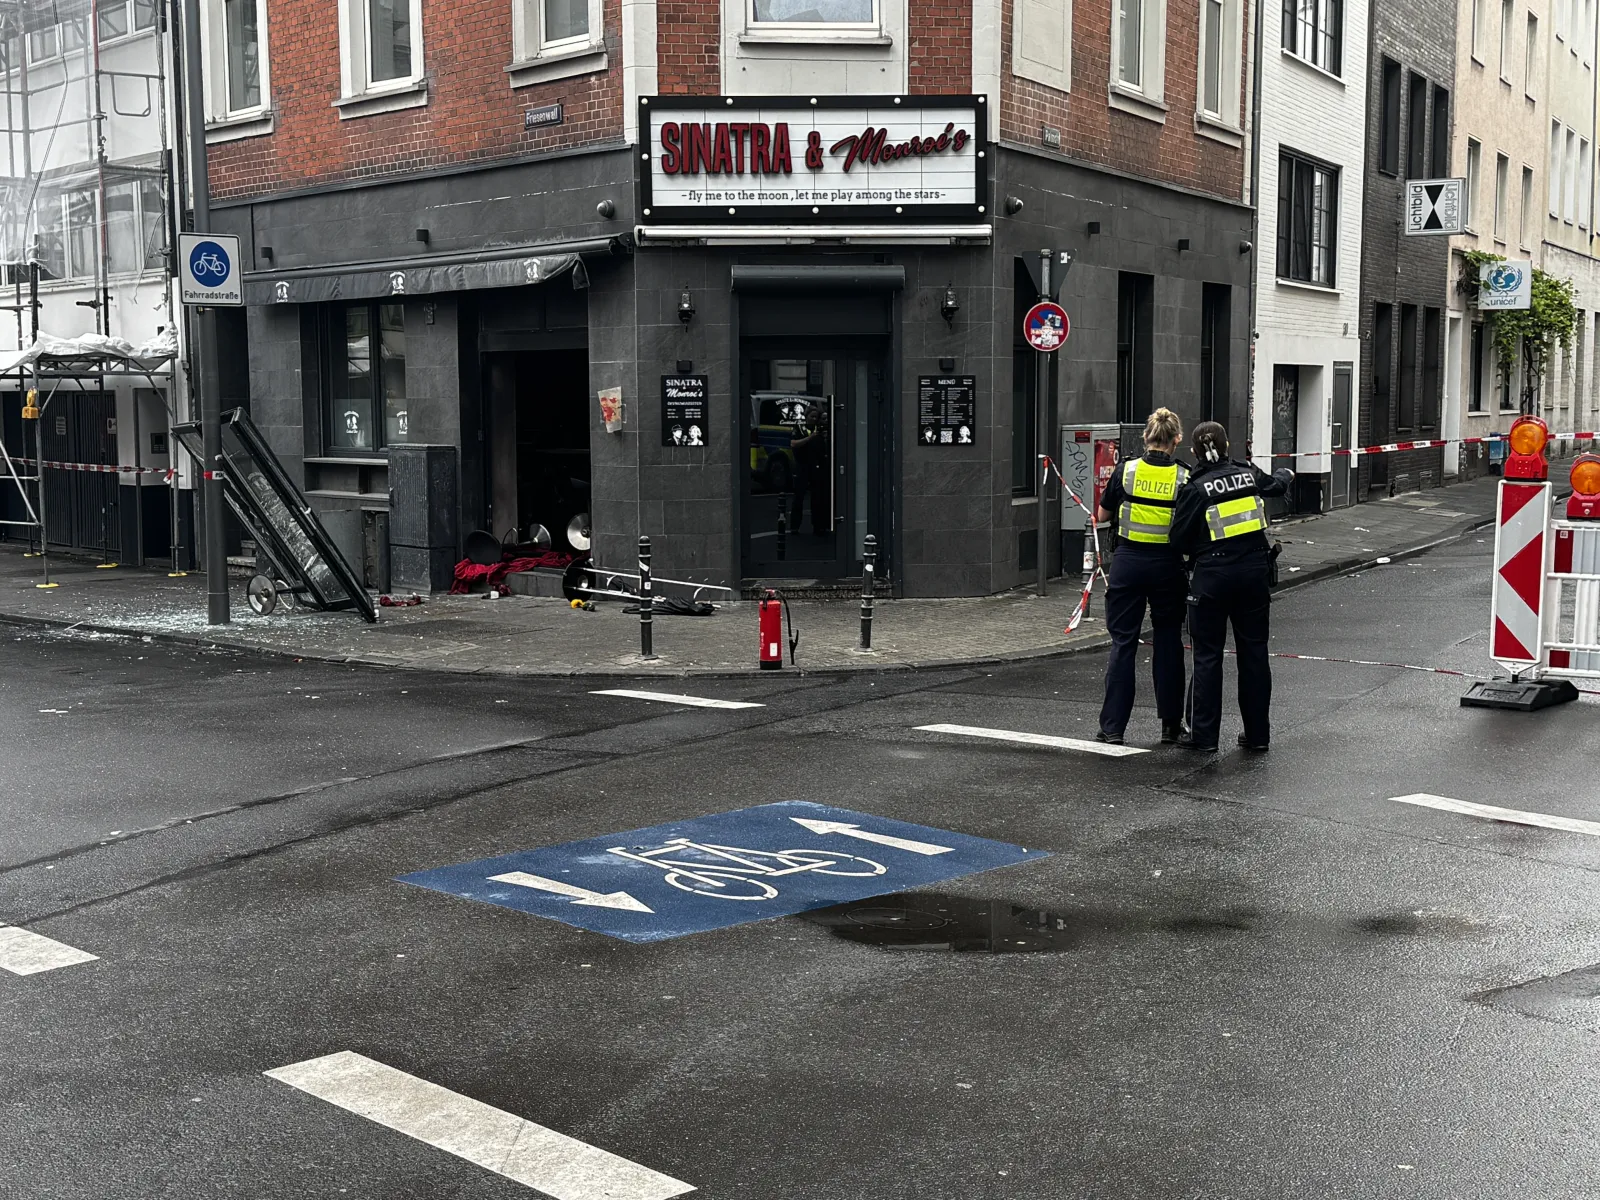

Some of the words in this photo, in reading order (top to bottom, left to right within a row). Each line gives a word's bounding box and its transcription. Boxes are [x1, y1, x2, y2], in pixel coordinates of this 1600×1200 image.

[526, 107, 558, 125] Friesenwall
[660, 121, 793, 174] SINATRA
[805, 130, 824, 170] &
[706, 192, 722, 200] me
[725, 191, 736, 200] to
[738, 189, 755, 200] the
[811, 192, 829, 200] me
[831, 189, 853, 202] play
[855, 191, 892, 202] among
[895, 189, 912, 199] the
[1410, 185, 1423, 231] Lichtbild
[1444, 183, 1458, 230] Lichtbild
[184, 290, 239, 300] Fahrradstraße
[1490, 297, 1517, 306] unicef
[666, 379, 703, 387] SINATRA
[1135, 479, 1173, 495] POLIZEI
[1203, 472, 1256, 497] POLIZEI
